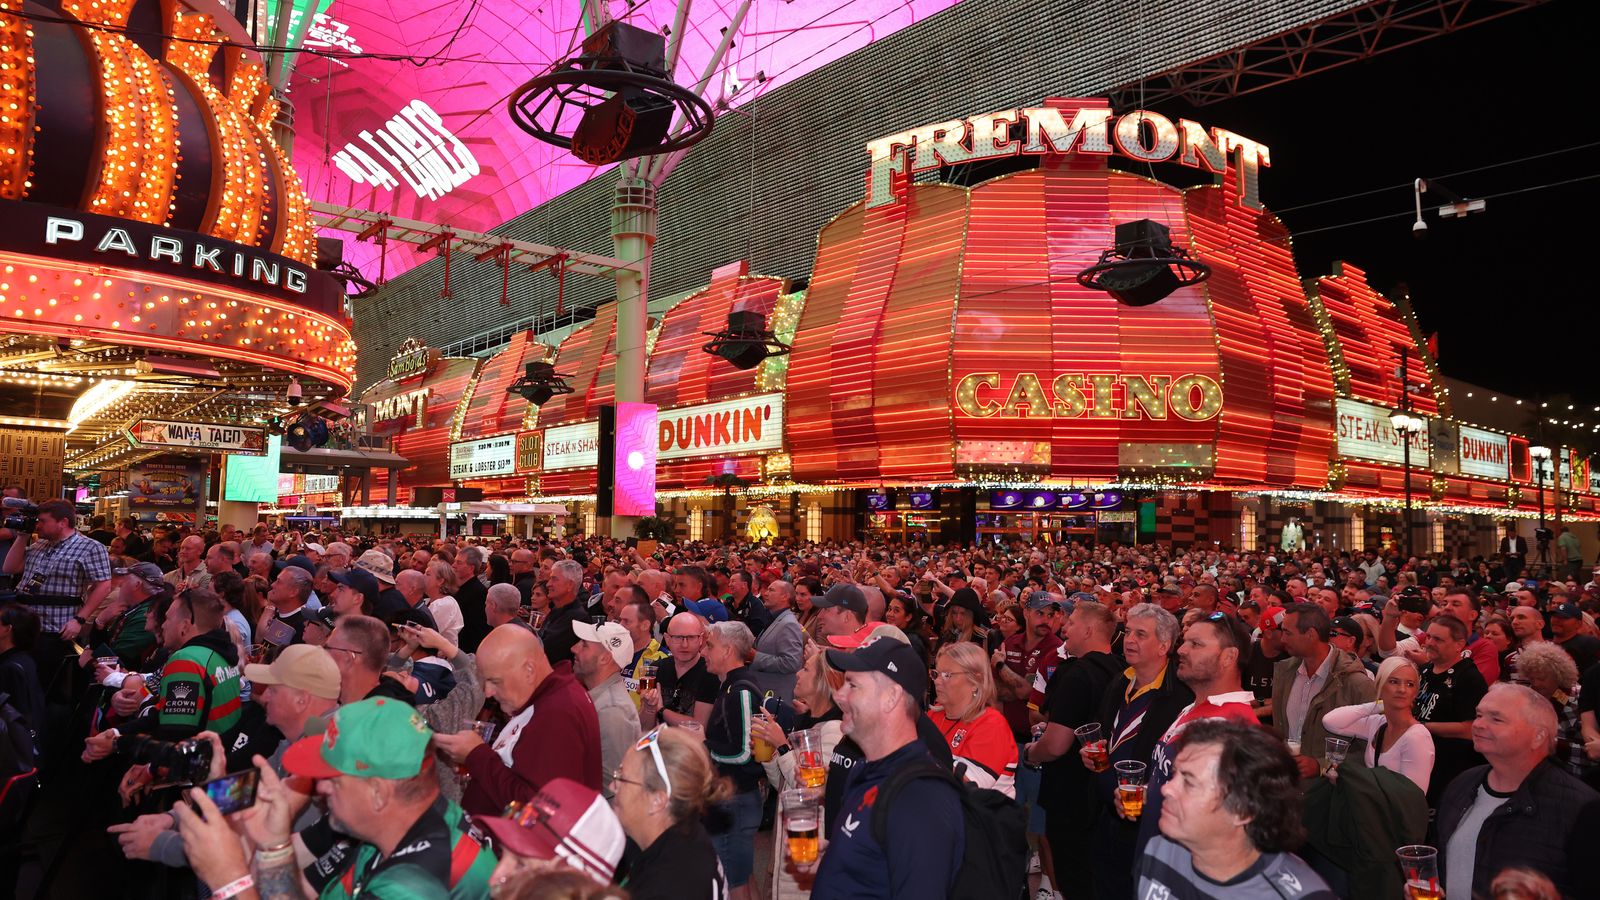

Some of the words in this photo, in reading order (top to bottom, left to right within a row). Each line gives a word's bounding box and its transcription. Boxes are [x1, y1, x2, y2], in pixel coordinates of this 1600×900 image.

[865, 107, 1271, 211] FREMONT
[45, 215, 307, 294] PARKING
[955, 371, 1224, 423] CASINO
[168, 424, 202, 441] WANA
[207, 427, 241, 443] TACO
[659, 404, 771, 452] DUNKIN'
[1340, 414, 1380, 443] STEAK
[520, 435, 540, 452] SLOT
[547, 440, 570, 456] STEAK
[578, 437, 599, 453] SHAK
[1463, 436, 1506, 465] DUNKIN'
[453, 464, 467, 475] STEAK
[475, 460, 496, 472] LOBSTER
[520, 453, 538, 468] CLUB
